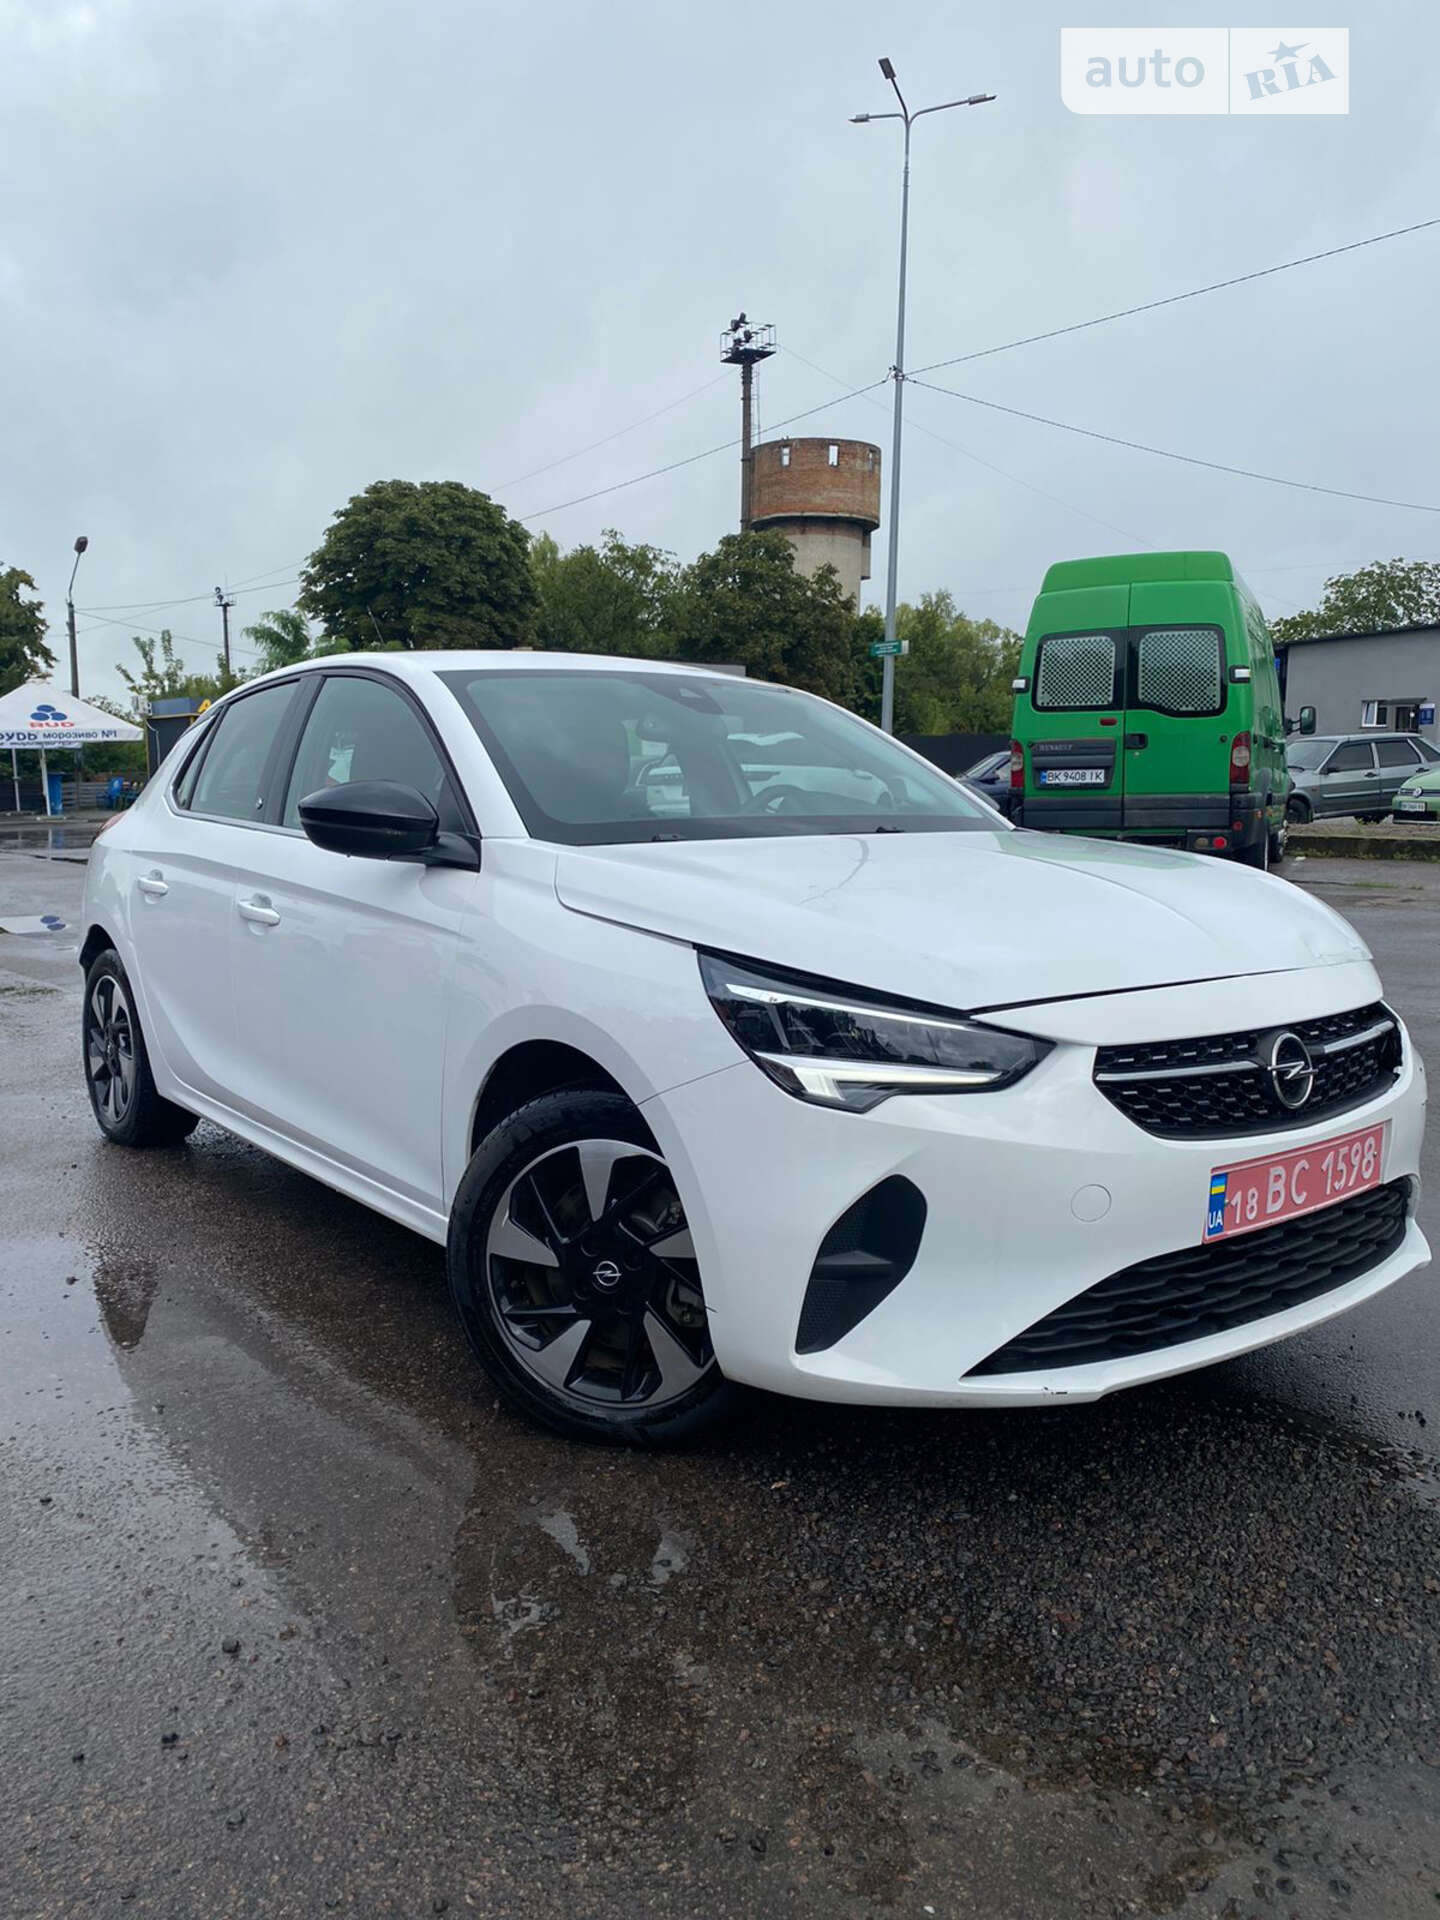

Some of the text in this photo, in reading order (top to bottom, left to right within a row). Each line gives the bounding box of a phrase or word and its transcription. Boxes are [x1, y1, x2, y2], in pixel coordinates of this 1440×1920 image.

[43, 731, 98, 741] морозиво
[1047, 771, 1061, 782] BK
[1063, 771, 1087, 782] 9408
[1230, 1136, 1376, 1224] 18 BC 1598
[1208, 1211, 1223, 1229] UA
